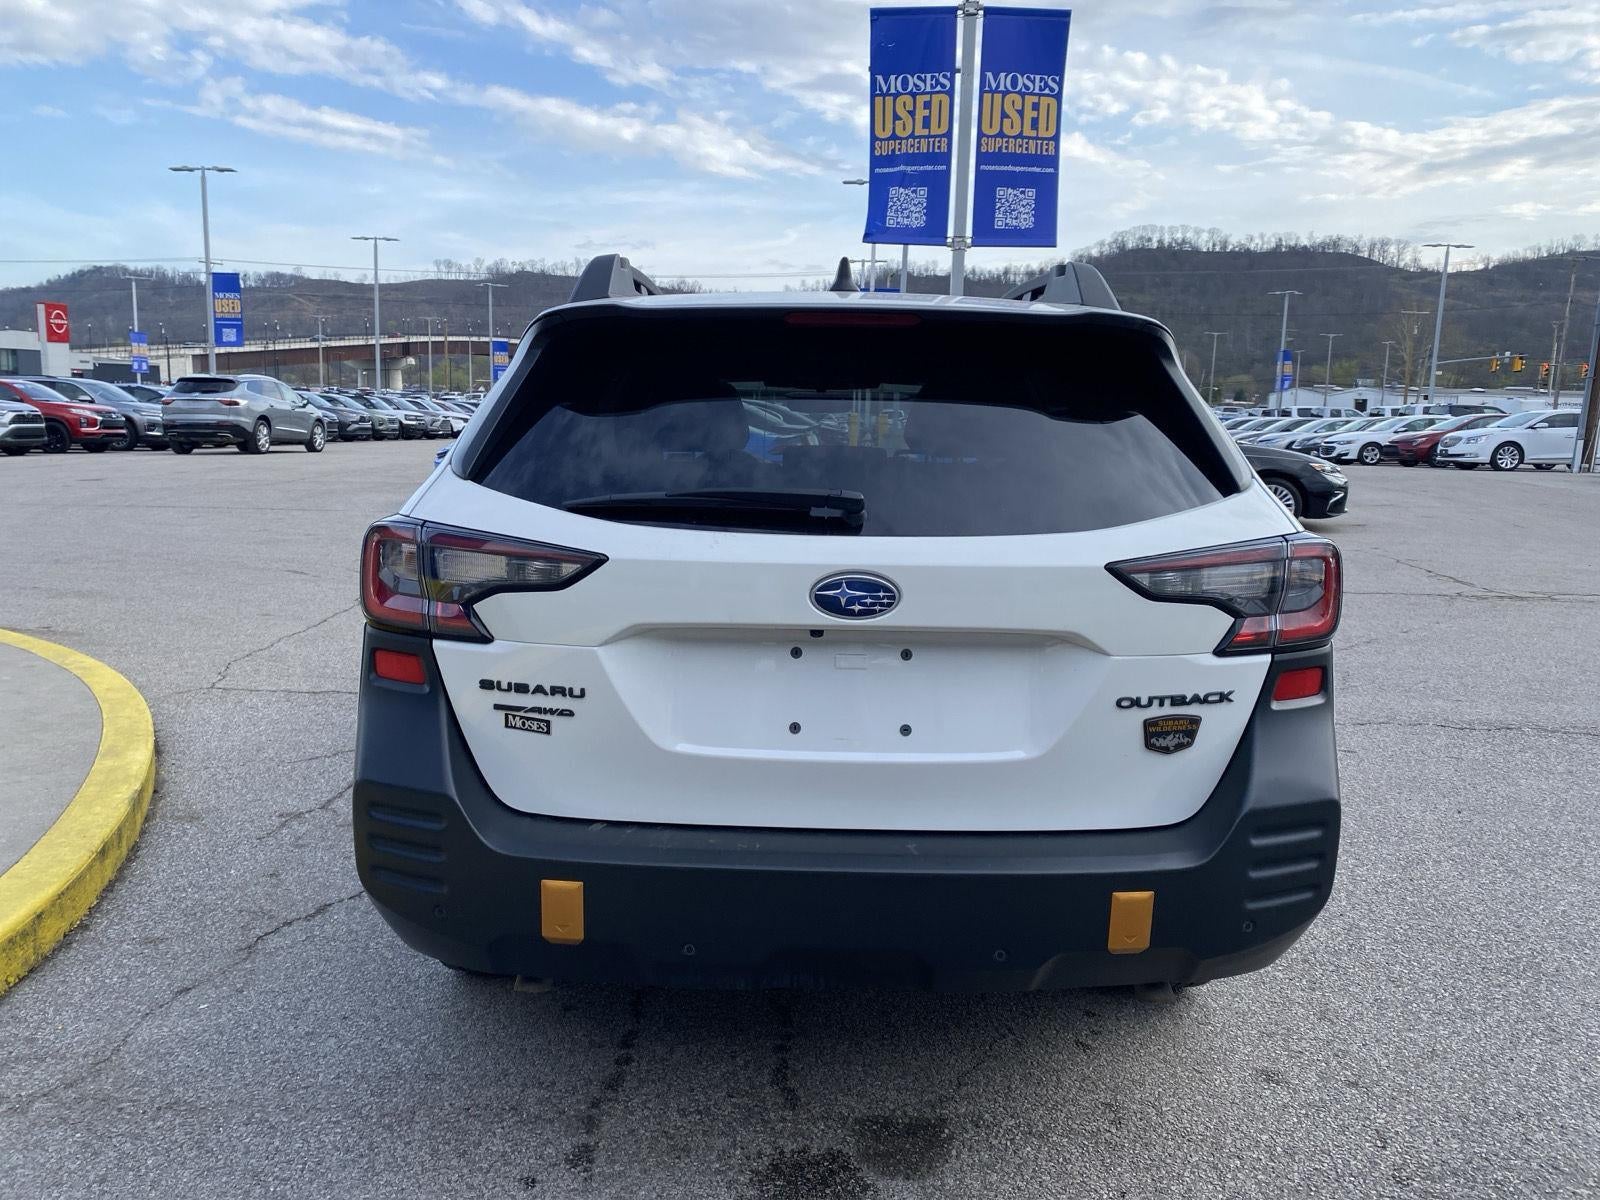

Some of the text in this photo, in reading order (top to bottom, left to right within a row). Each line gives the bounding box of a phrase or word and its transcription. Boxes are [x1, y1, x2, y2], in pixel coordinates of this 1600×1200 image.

[875, 71, 951, 94] MOSES
[984, 71, 1060, 95] MOSES
[874, 94, 950, 138] USED
[981, 93, 1058, 138] USED
[875, 138, 948, 156] SUPERCENTER
[981, 137, 1056, 155] SUPERCENTER
[215, 299, 241, 313] USED
[479, 679, 586, 698] SUBARU
[1116, 690, 1235, 709] OUTBACK
[524, 706, 575, 717] AWD
[1148, 725, 1198, 733] WILDERNESS
